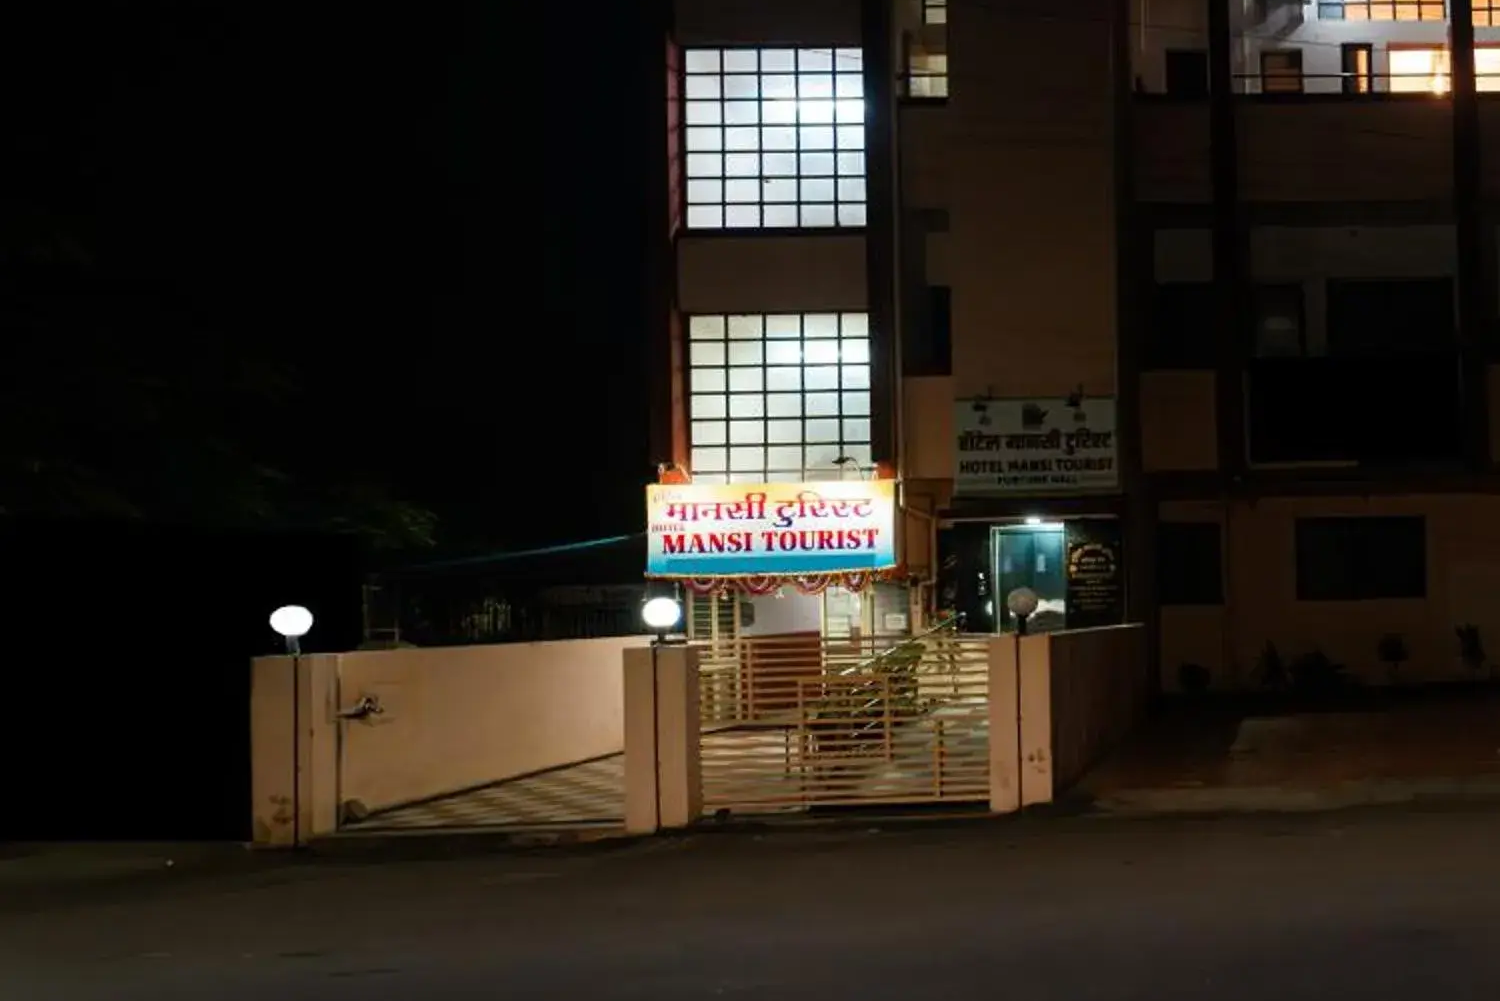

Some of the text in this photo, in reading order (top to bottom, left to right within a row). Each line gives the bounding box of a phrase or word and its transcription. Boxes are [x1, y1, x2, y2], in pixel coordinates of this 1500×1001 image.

[959, 457, 1113, 473] HOTEL MANSI TOURIST
[666, 492, 766, 521] मानसी
[662, 529, 879, 554] MANSI TOURIST
